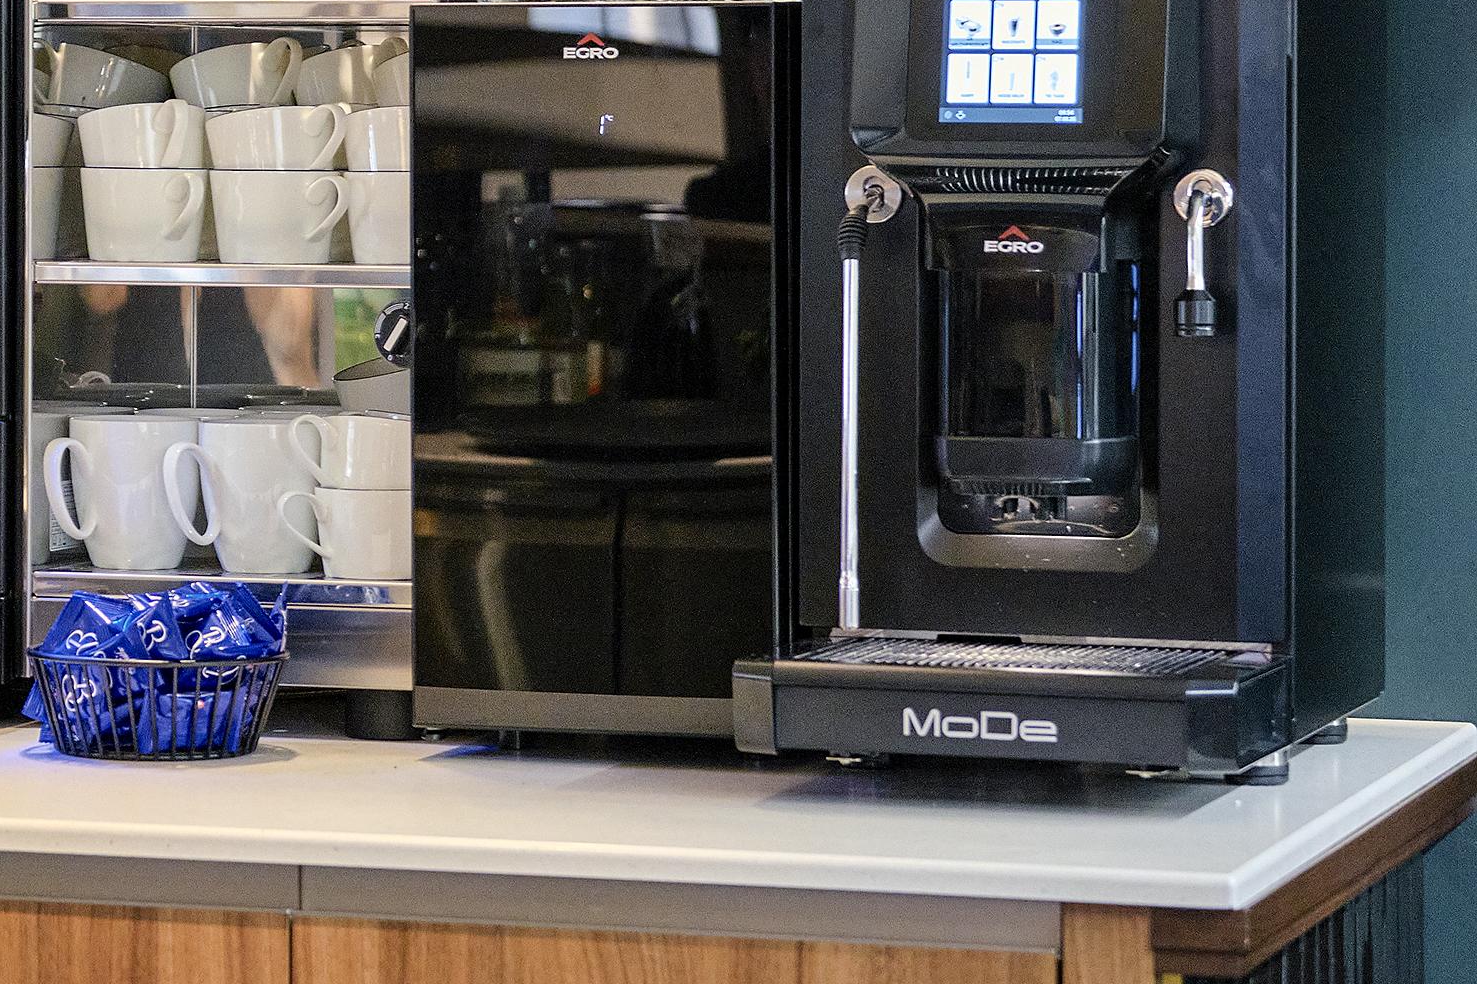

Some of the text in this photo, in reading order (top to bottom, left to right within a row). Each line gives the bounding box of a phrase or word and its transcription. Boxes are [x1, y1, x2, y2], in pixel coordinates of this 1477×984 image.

[563, 47, 620, 59] EGRO
[984, 240, 1045, 254] EGRO
[902, 707, 1059, 743] MoDe
